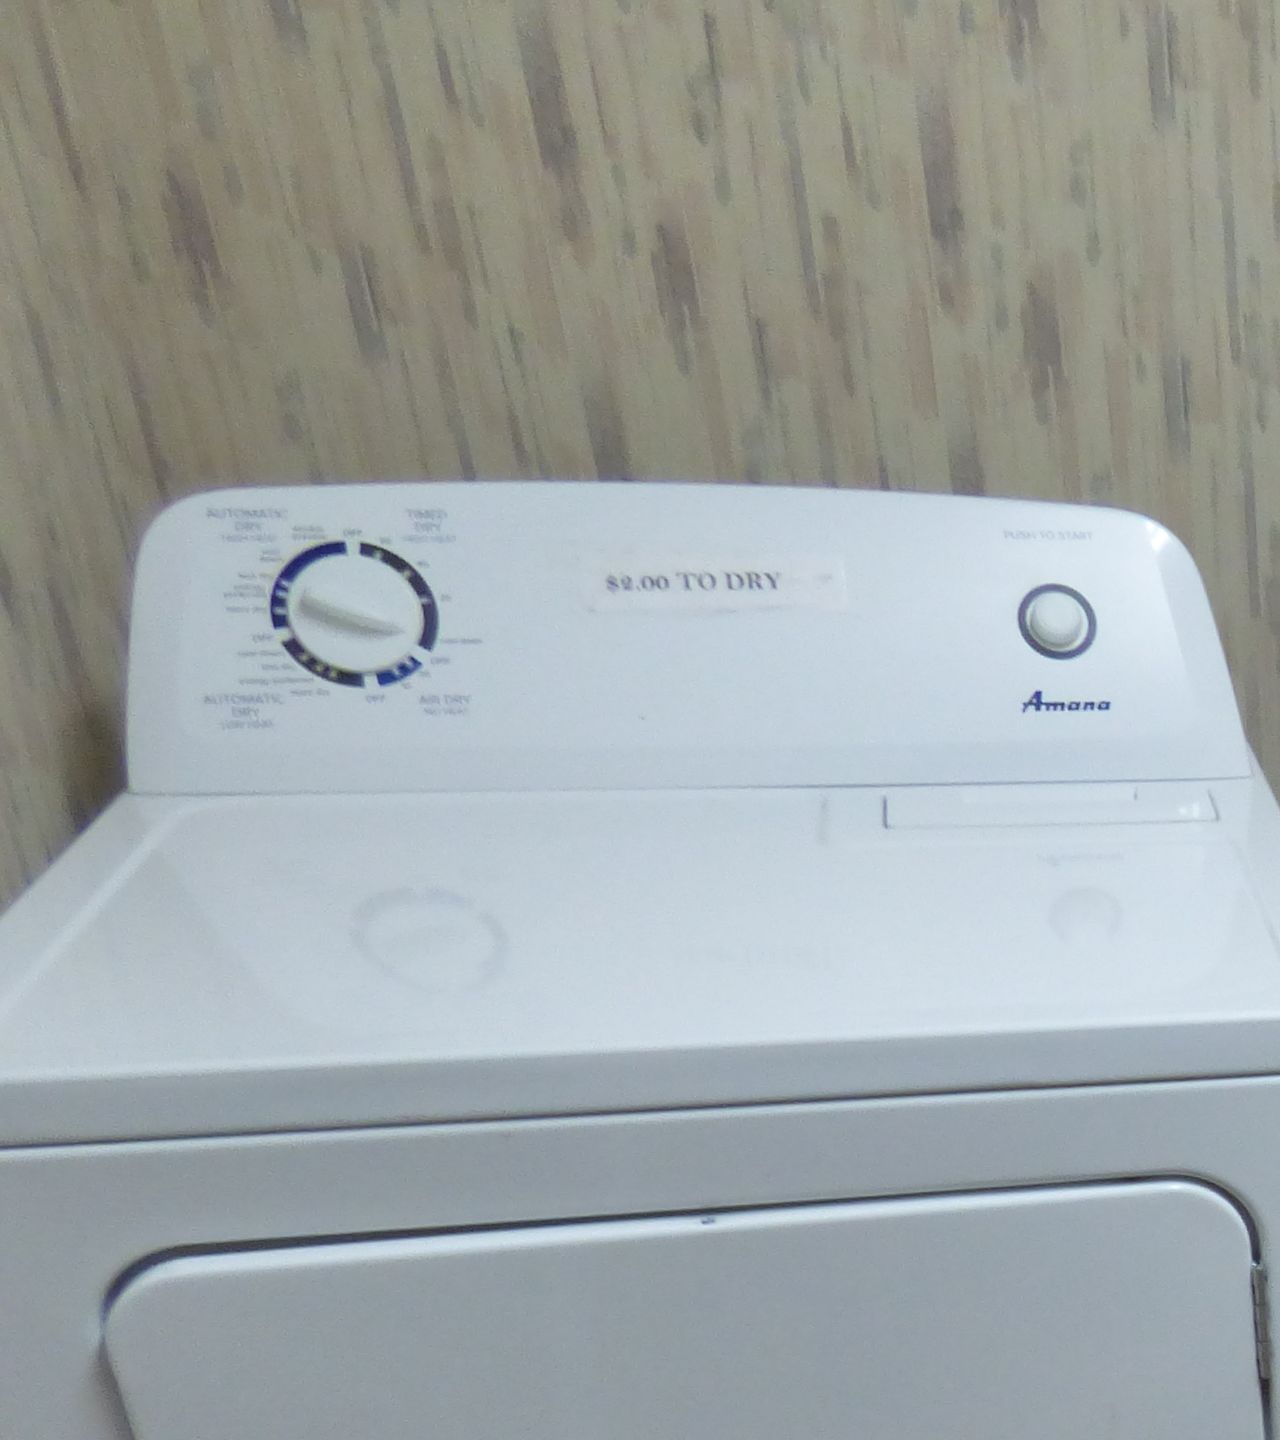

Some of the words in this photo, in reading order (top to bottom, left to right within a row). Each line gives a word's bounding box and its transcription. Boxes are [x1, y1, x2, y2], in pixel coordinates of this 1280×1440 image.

[1003, 529, 1036, 540] PUSH
[1039, 530, 1056, 541] TO
[1058, 530, 1093, 541] START
[605, 573, 671, 595] $2.00
[675, 570, 719, 593] TO
[720, 570, 783, 593] DRY
[1021, 688, 1113, 714] Amana
